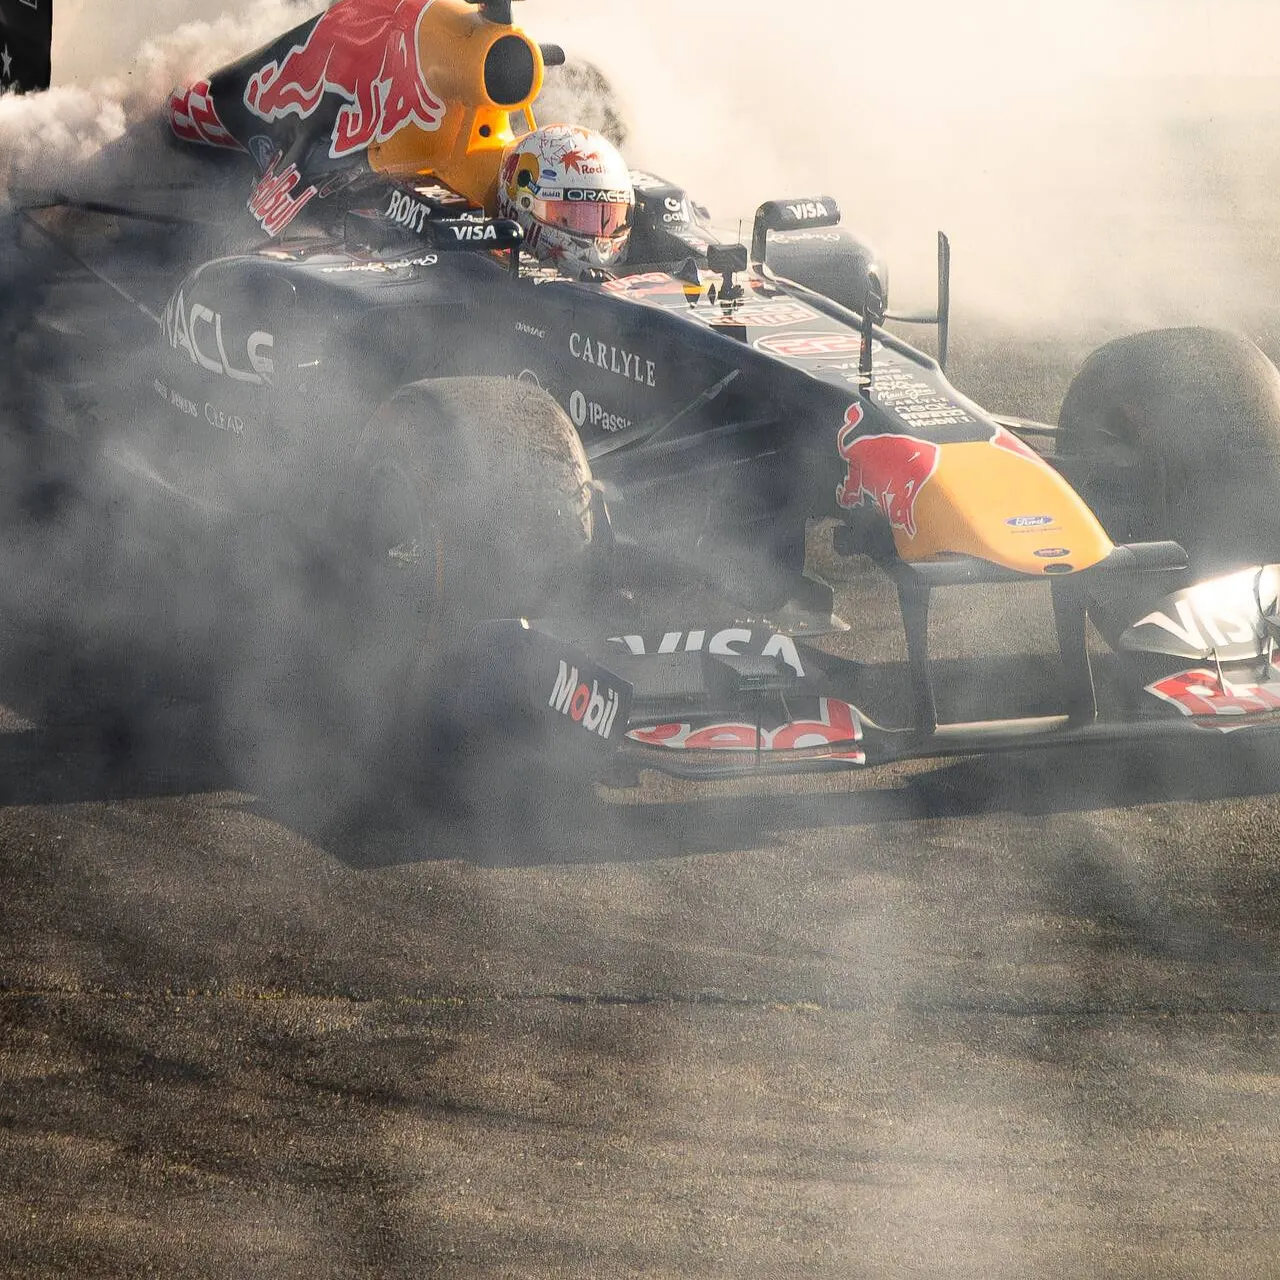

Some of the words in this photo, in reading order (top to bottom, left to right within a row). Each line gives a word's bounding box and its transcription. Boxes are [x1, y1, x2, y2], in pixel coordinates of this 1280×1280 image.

[449, 224, 497, 241] VISA
[787, 202, 829, 220] VISA
[160, 289, 274, 389] ACLE
[569, 332, 657, 388] CARLYLE
[548, 659, 619, 740] Mobil
